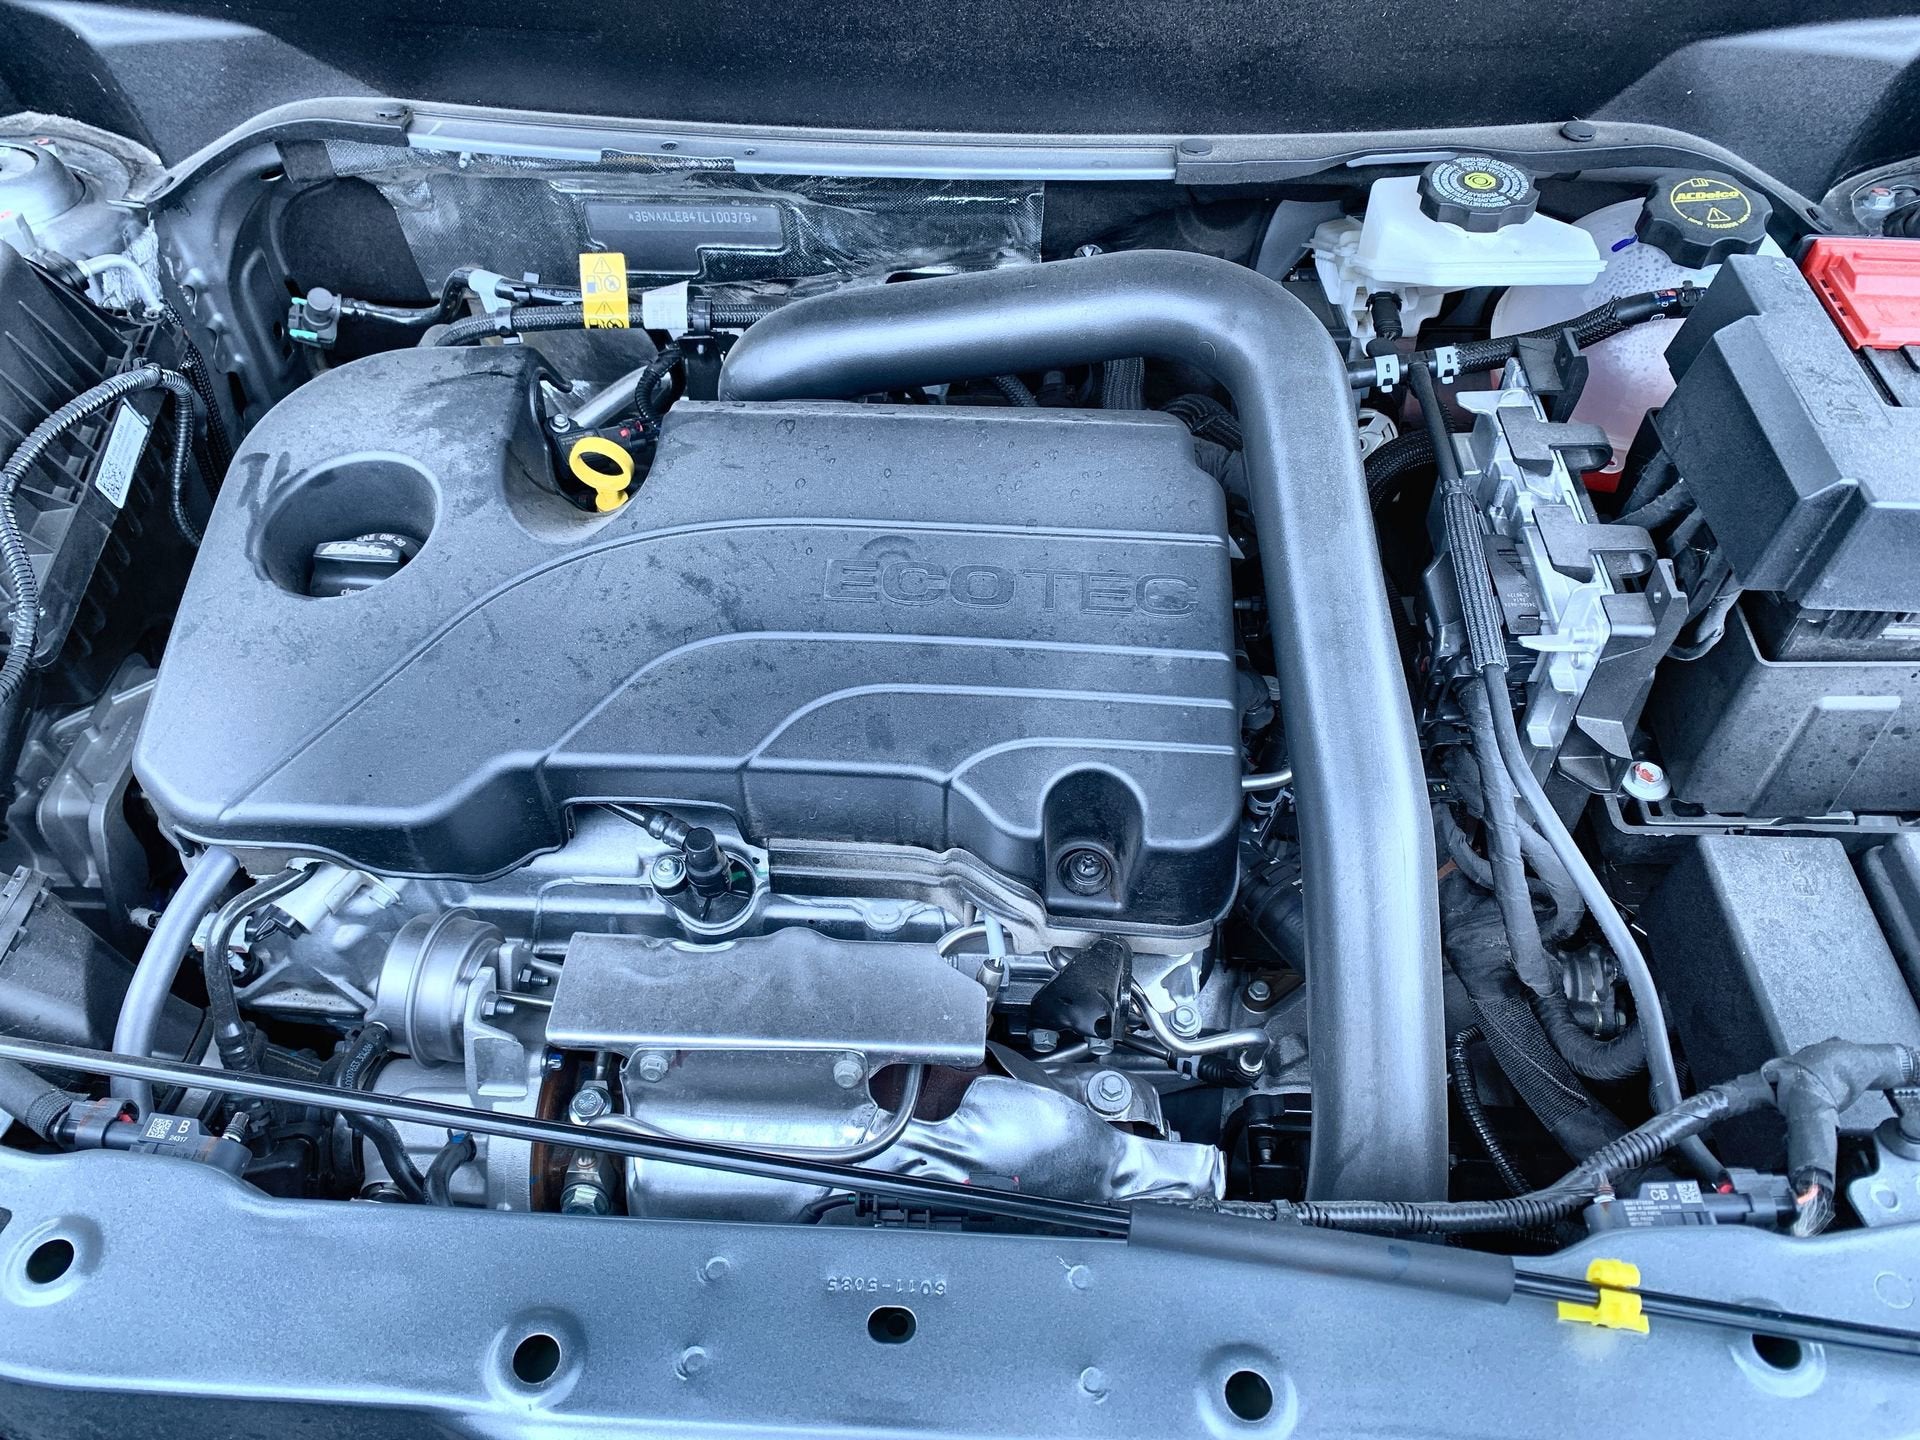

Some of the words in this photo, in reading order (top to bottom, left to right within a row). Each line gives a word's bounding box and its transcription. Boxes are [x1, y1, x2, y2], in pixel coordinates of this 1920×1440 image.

[1676, 191, 1739, 201] ACDelco
[356, 534, 376, 542] SAE
[379, 533, 407, 547] 0W-20
[320, 543, 393, 556] ACDelco
[824, 557, 1200, 618] ECOTEC
[177, 1119, 191, 1133] B
[168, 1134, 188, 1142] 24317
[1650, 1189, 1670, 1201] CB
